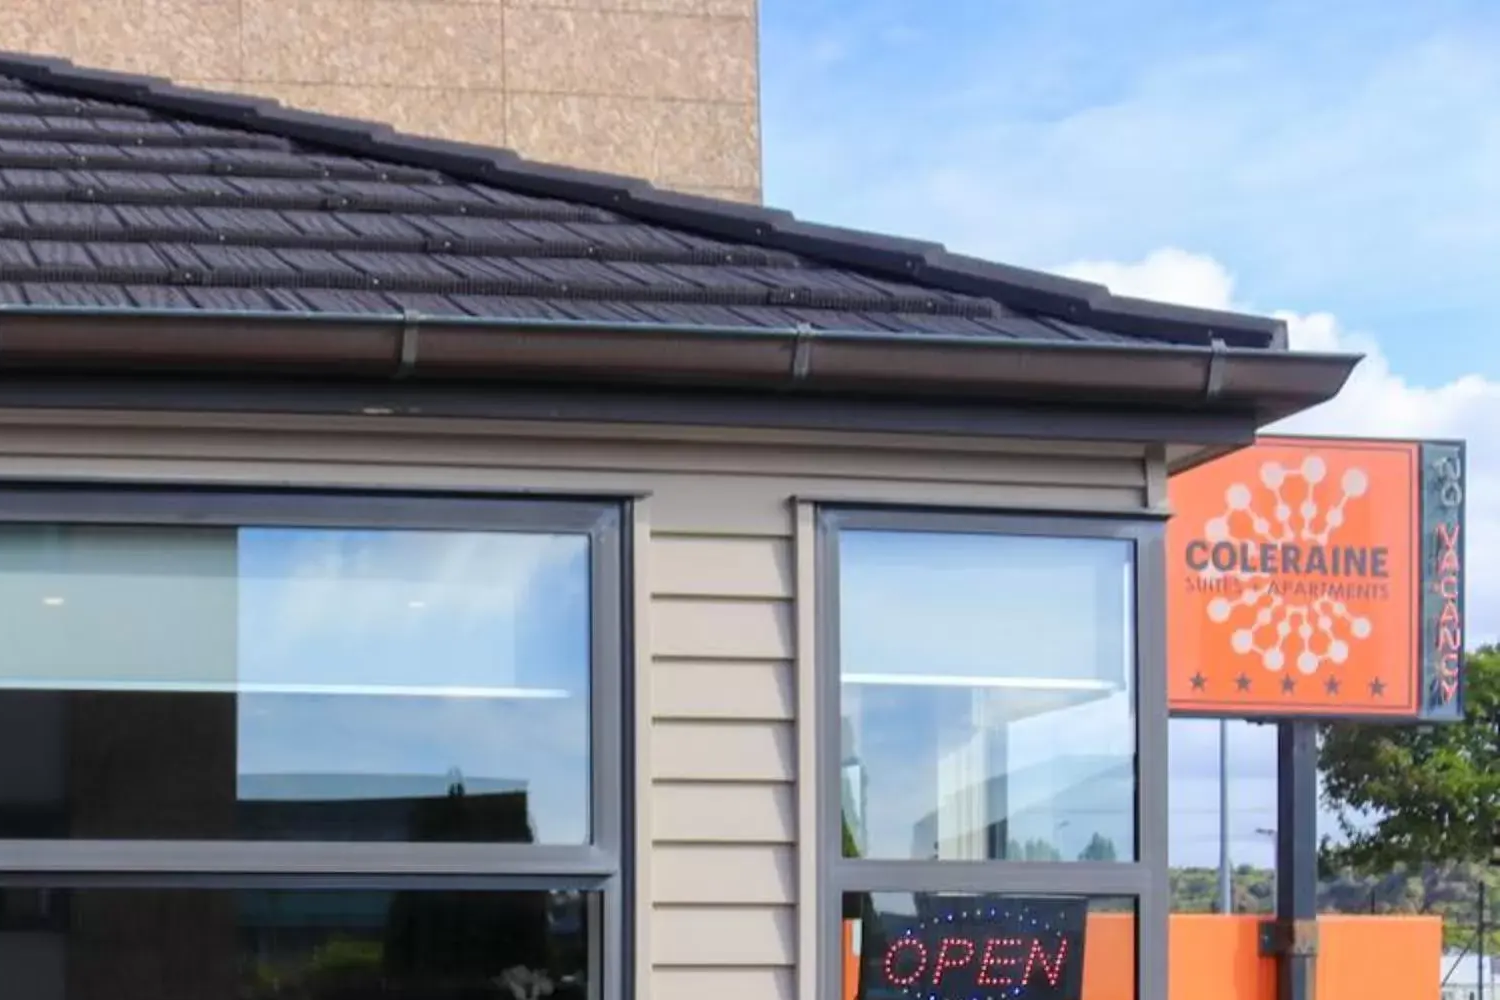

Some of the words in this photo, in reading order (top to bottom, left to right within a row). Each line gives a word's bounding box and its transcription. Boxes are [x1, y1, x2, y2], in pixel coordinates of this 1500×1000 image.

[1184, 540, 1390, 578] COLERAINE
[1185, 577, 1242, 593] SUITES
[1267, 579, 1390, 600] APARTMENTS
[1436, 522, 1461, 704] VACANCY
[883, 936, 1069, 986] OPEN
